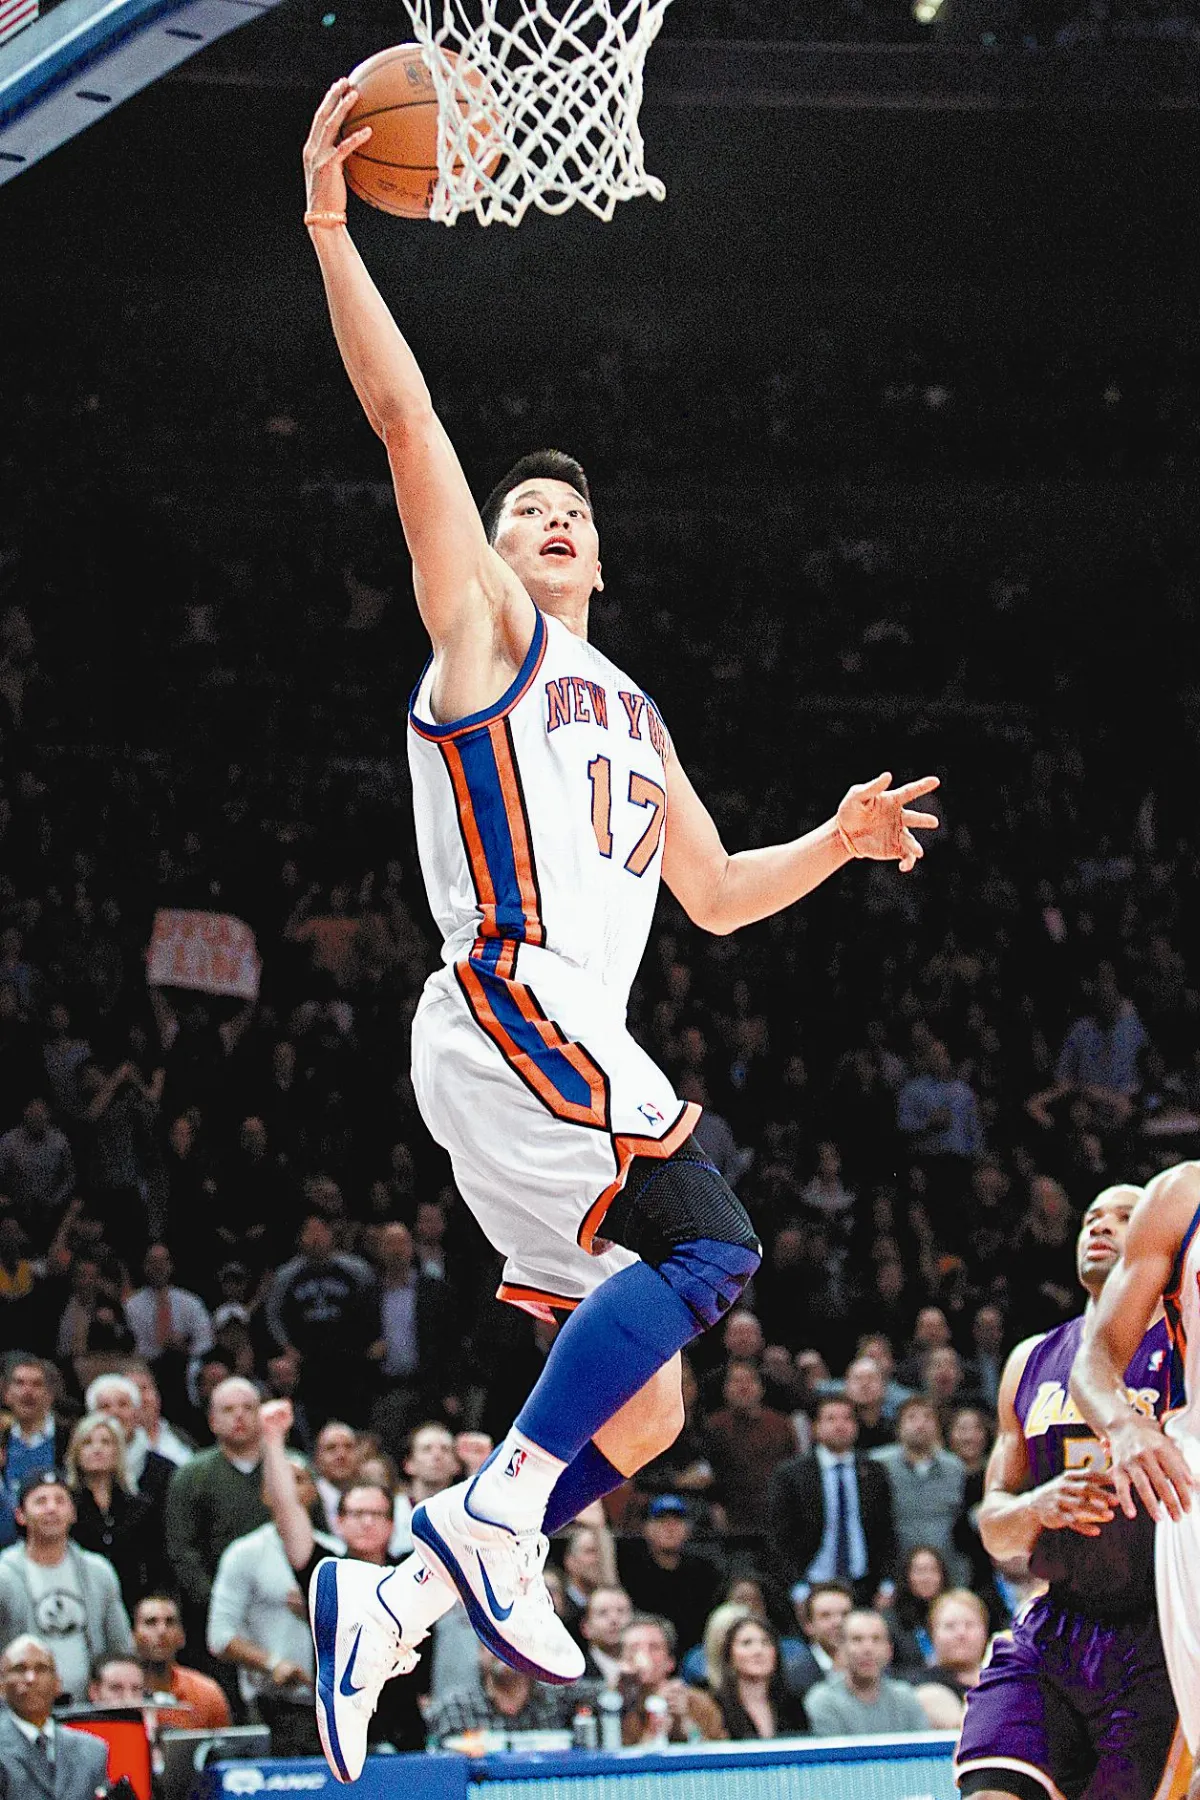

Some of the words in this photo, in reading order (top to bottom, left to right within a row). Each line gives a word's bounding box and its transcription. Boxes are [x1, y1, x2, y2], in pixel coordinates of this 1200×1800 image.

[545, 676, 608, 733] NEW
[618, 691, 669, 759] YO
[587, 753, 665, 878] 17
